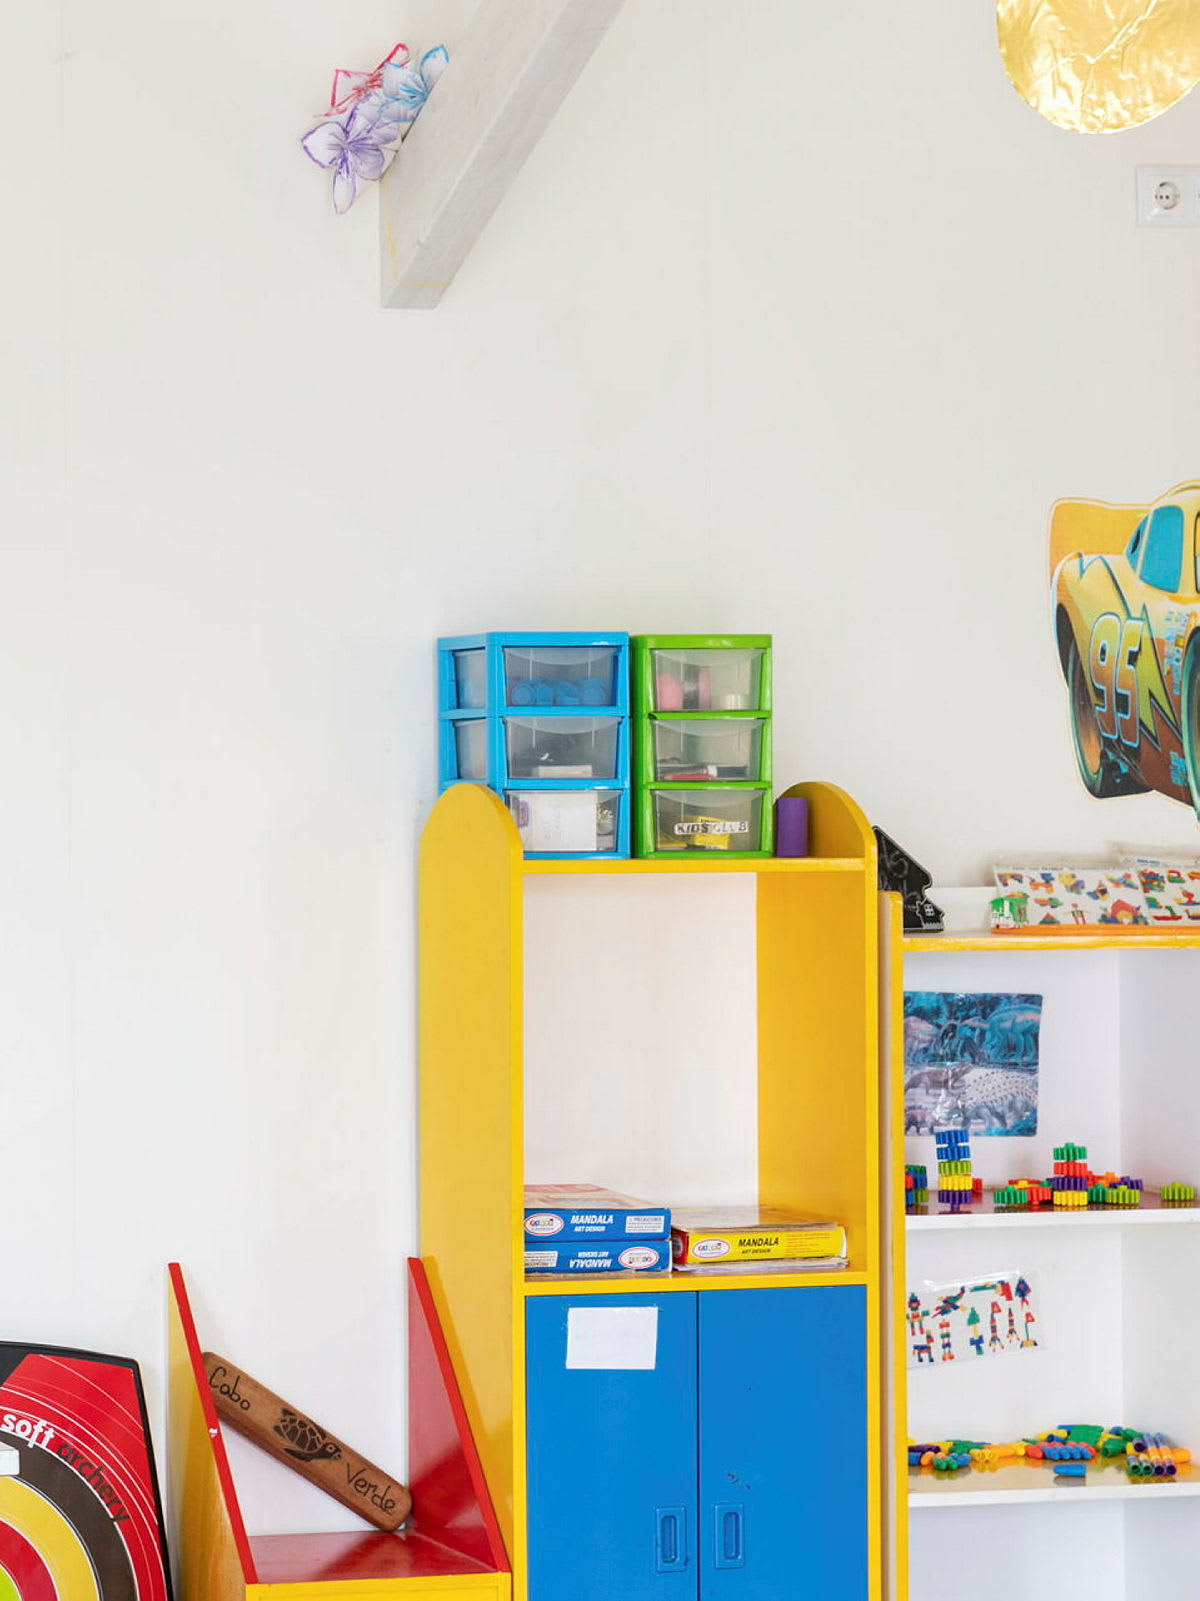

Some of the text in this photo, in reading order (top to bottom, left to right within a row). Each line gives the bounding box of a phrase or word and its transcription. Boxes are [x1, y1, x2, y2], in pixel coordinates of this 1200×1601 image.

[1089, 612, 1144, 748] 95
[677, 823, 709, 834] KIDS
[570, 1214, 614, 1224] MANDALA
[738, 1237, 779, 1246] MANDALA
[569, 1259, 612, 1268] MANDALA
[1, 1413, 130, 1522] soft archery
[346, 1463, 397, 1517] Verde
